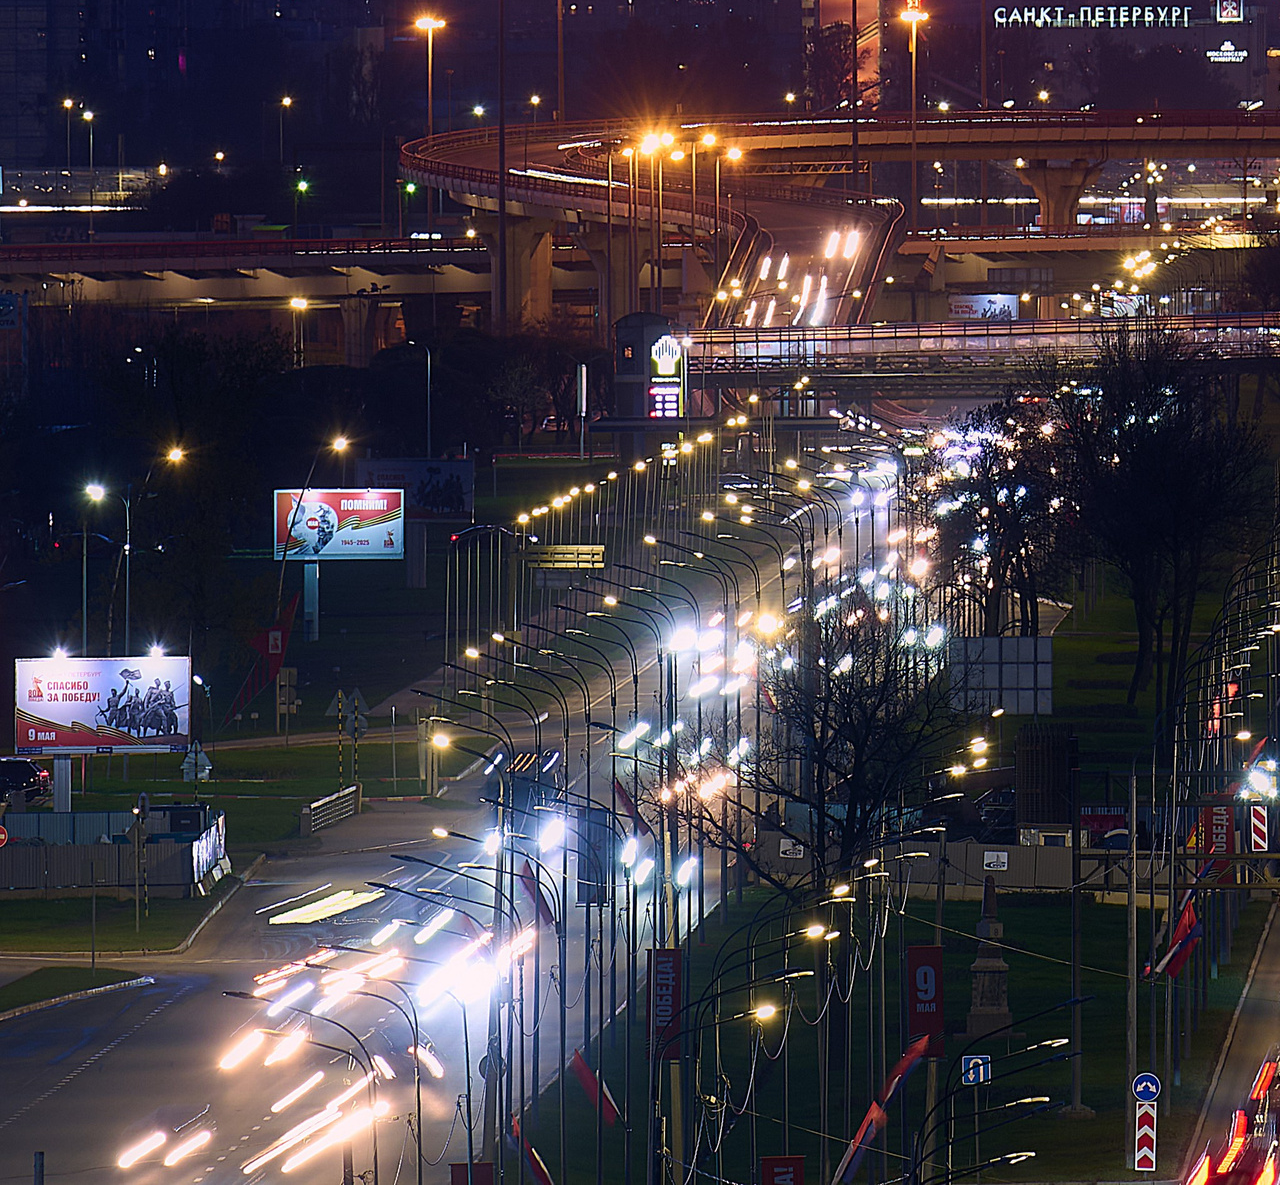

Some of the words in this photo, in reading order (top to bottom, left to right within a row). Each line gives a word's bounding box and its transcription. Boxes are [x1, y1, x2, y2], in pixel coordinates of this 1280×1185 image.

[341, 499, 388, 511] ПОМНИМ!
[47, 681, 89, 691] СПАСИБО
[47, 693, 59, 702] ЗА
[62, 692, 100, 703] ПОБЕДУ!
[28, 728, 35, 741] 9
[37, 732, 56, 741] МАЯ
[916, 965, 936, 1001] 9
[656, 957, 675, 1027] ПОБЕДА!
[916, 1002, 937, 1013] МАЯ
